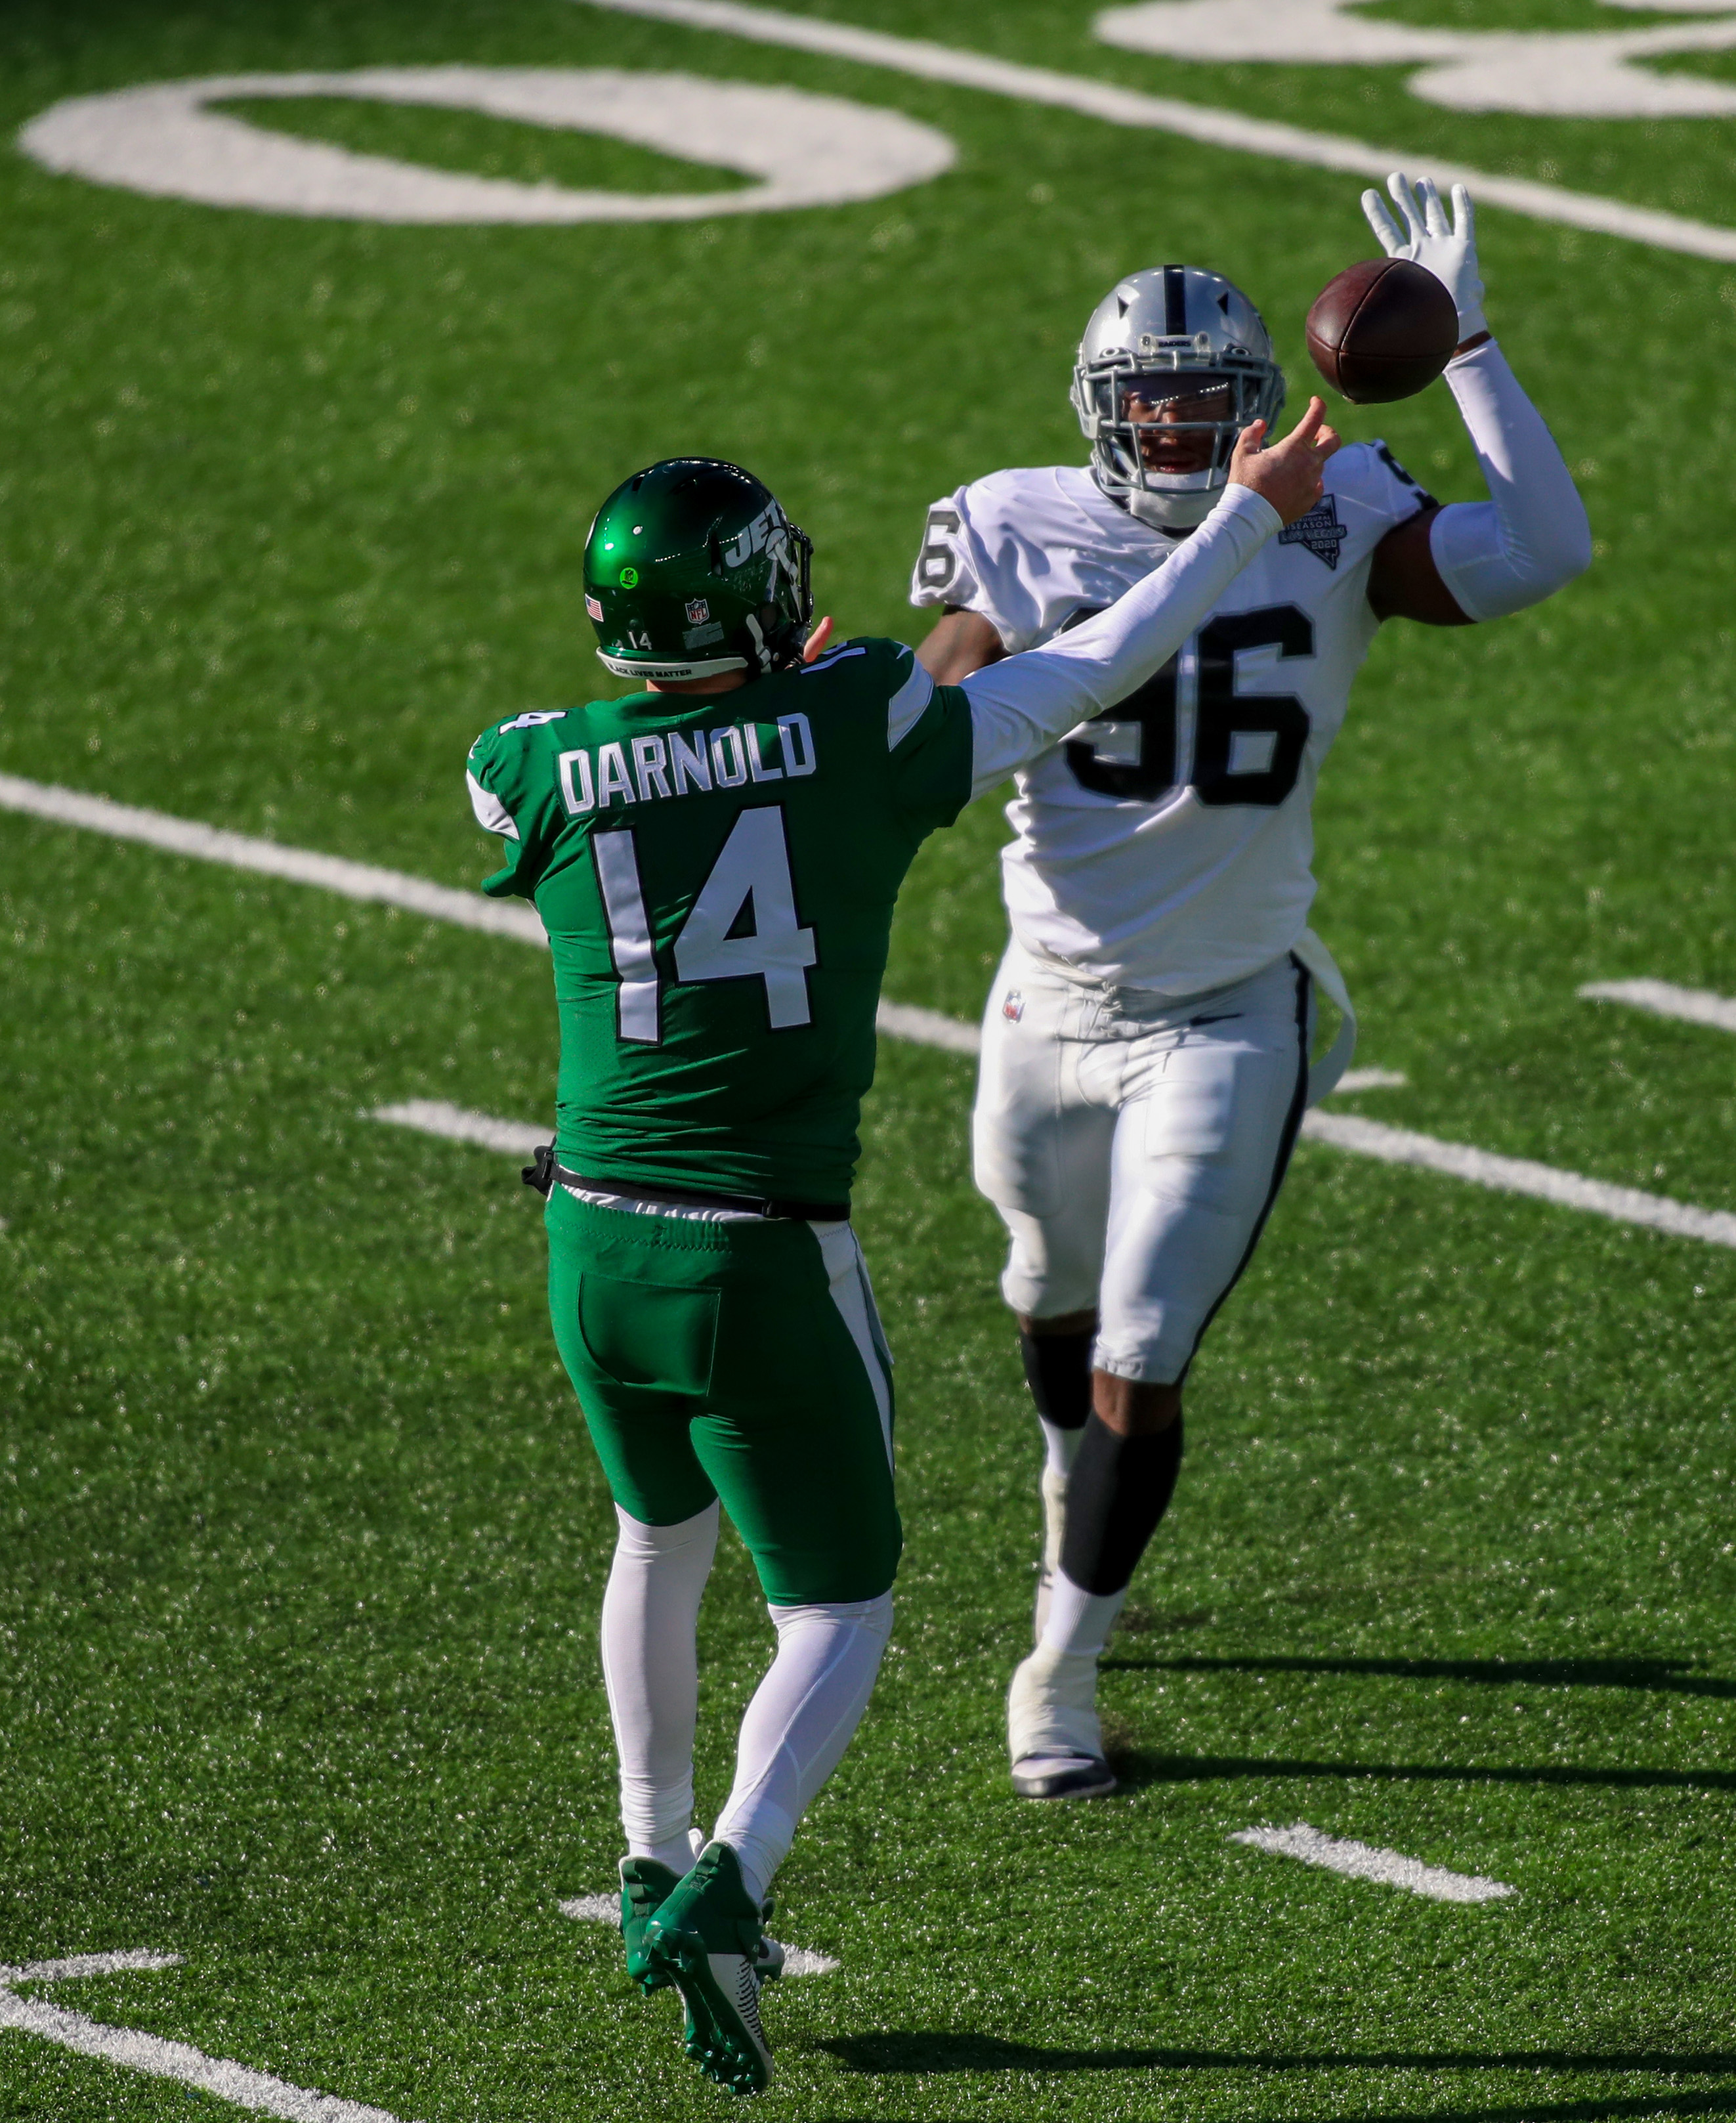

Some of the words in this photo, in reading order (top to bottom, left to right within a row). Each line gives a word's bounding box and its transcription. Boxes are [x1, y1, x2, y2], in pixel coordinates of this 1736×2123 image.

[1291, 521, 1331, 529] SEASON
[1311, 539, 1337, 549] 2020
[690, 608, 707, 620] NFL
[627, 631, 652, 650] 14
[608, 662, 629, 675] ACK
[629, 669, 655, 677] LIVES
[654, 669, 692, 677] MATTER
[558, 712, 816, 815] DARNOLD
[591, 804, 818, 1044] 14
